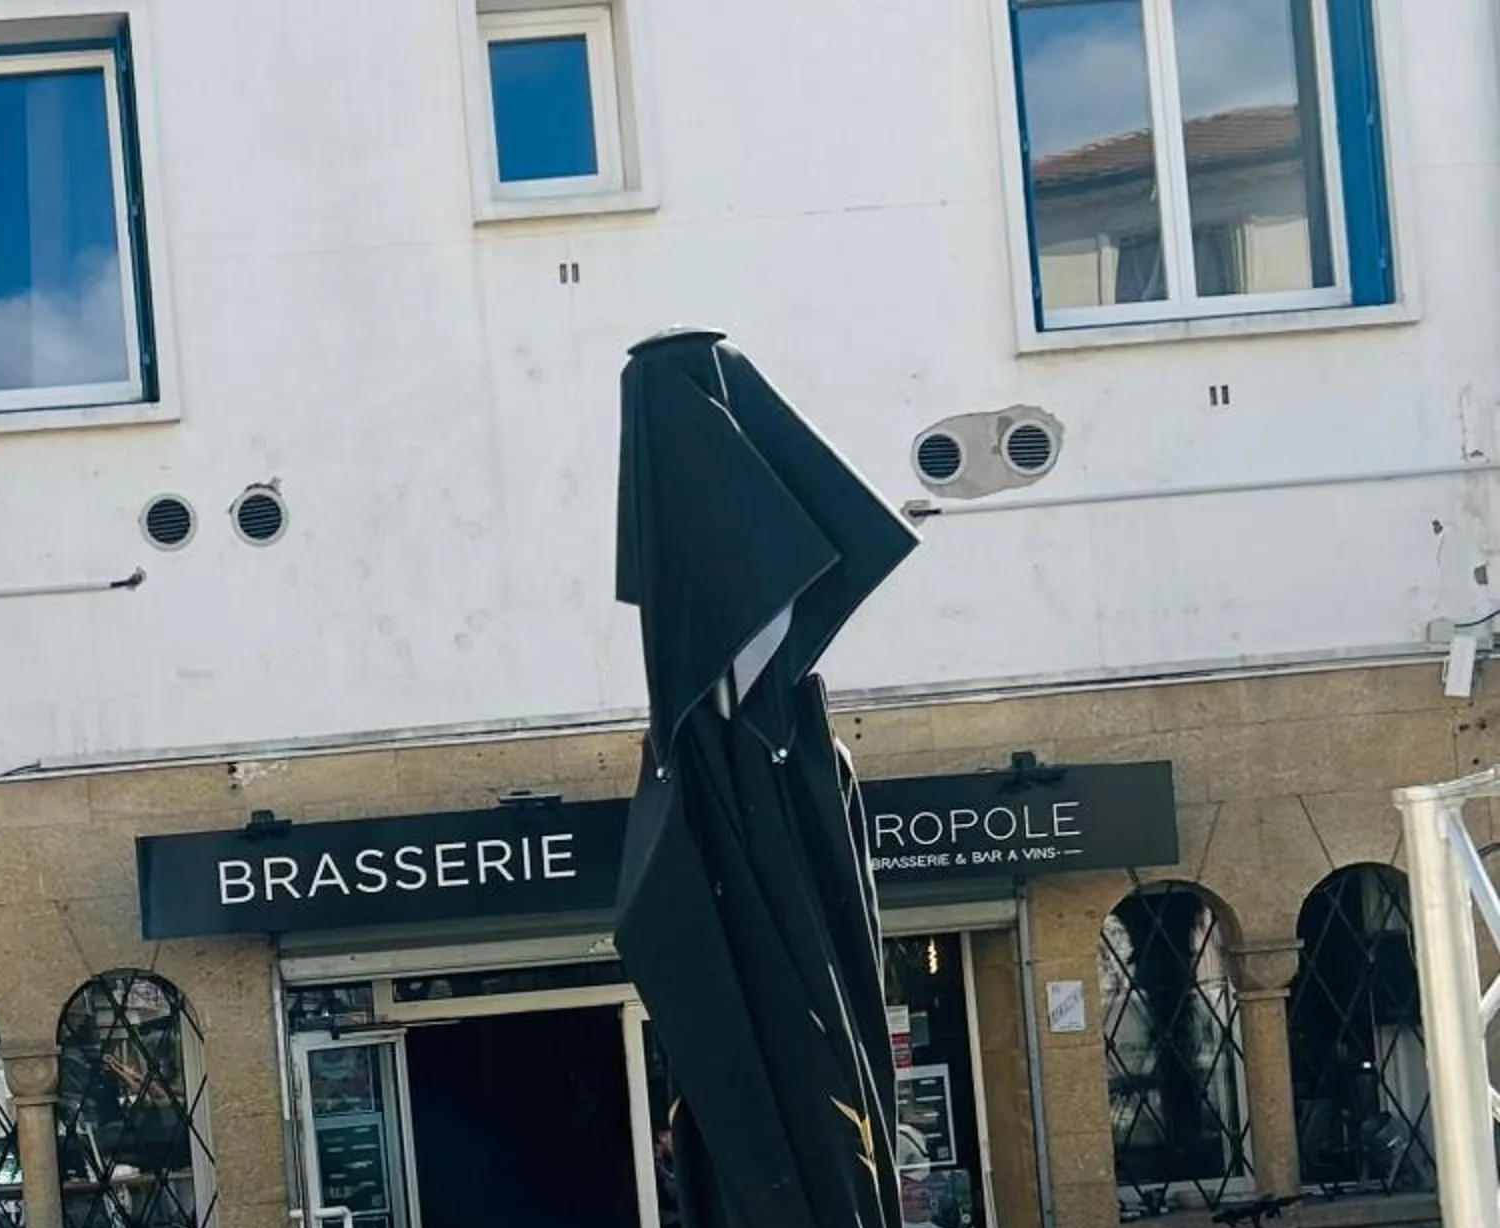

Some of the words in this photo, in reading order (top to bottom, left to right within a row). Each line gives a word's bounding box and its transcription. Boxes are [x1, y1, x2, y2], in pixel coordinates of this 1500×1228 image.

[875, 801, 1082, 849] ROPOLE
[216, 833, 577, 904] BRASSERIE
[871, 853, 950, 871] BRASSERIE
[955, 853, 967, 866] &
[972, 850, 1002, 864] BAR
